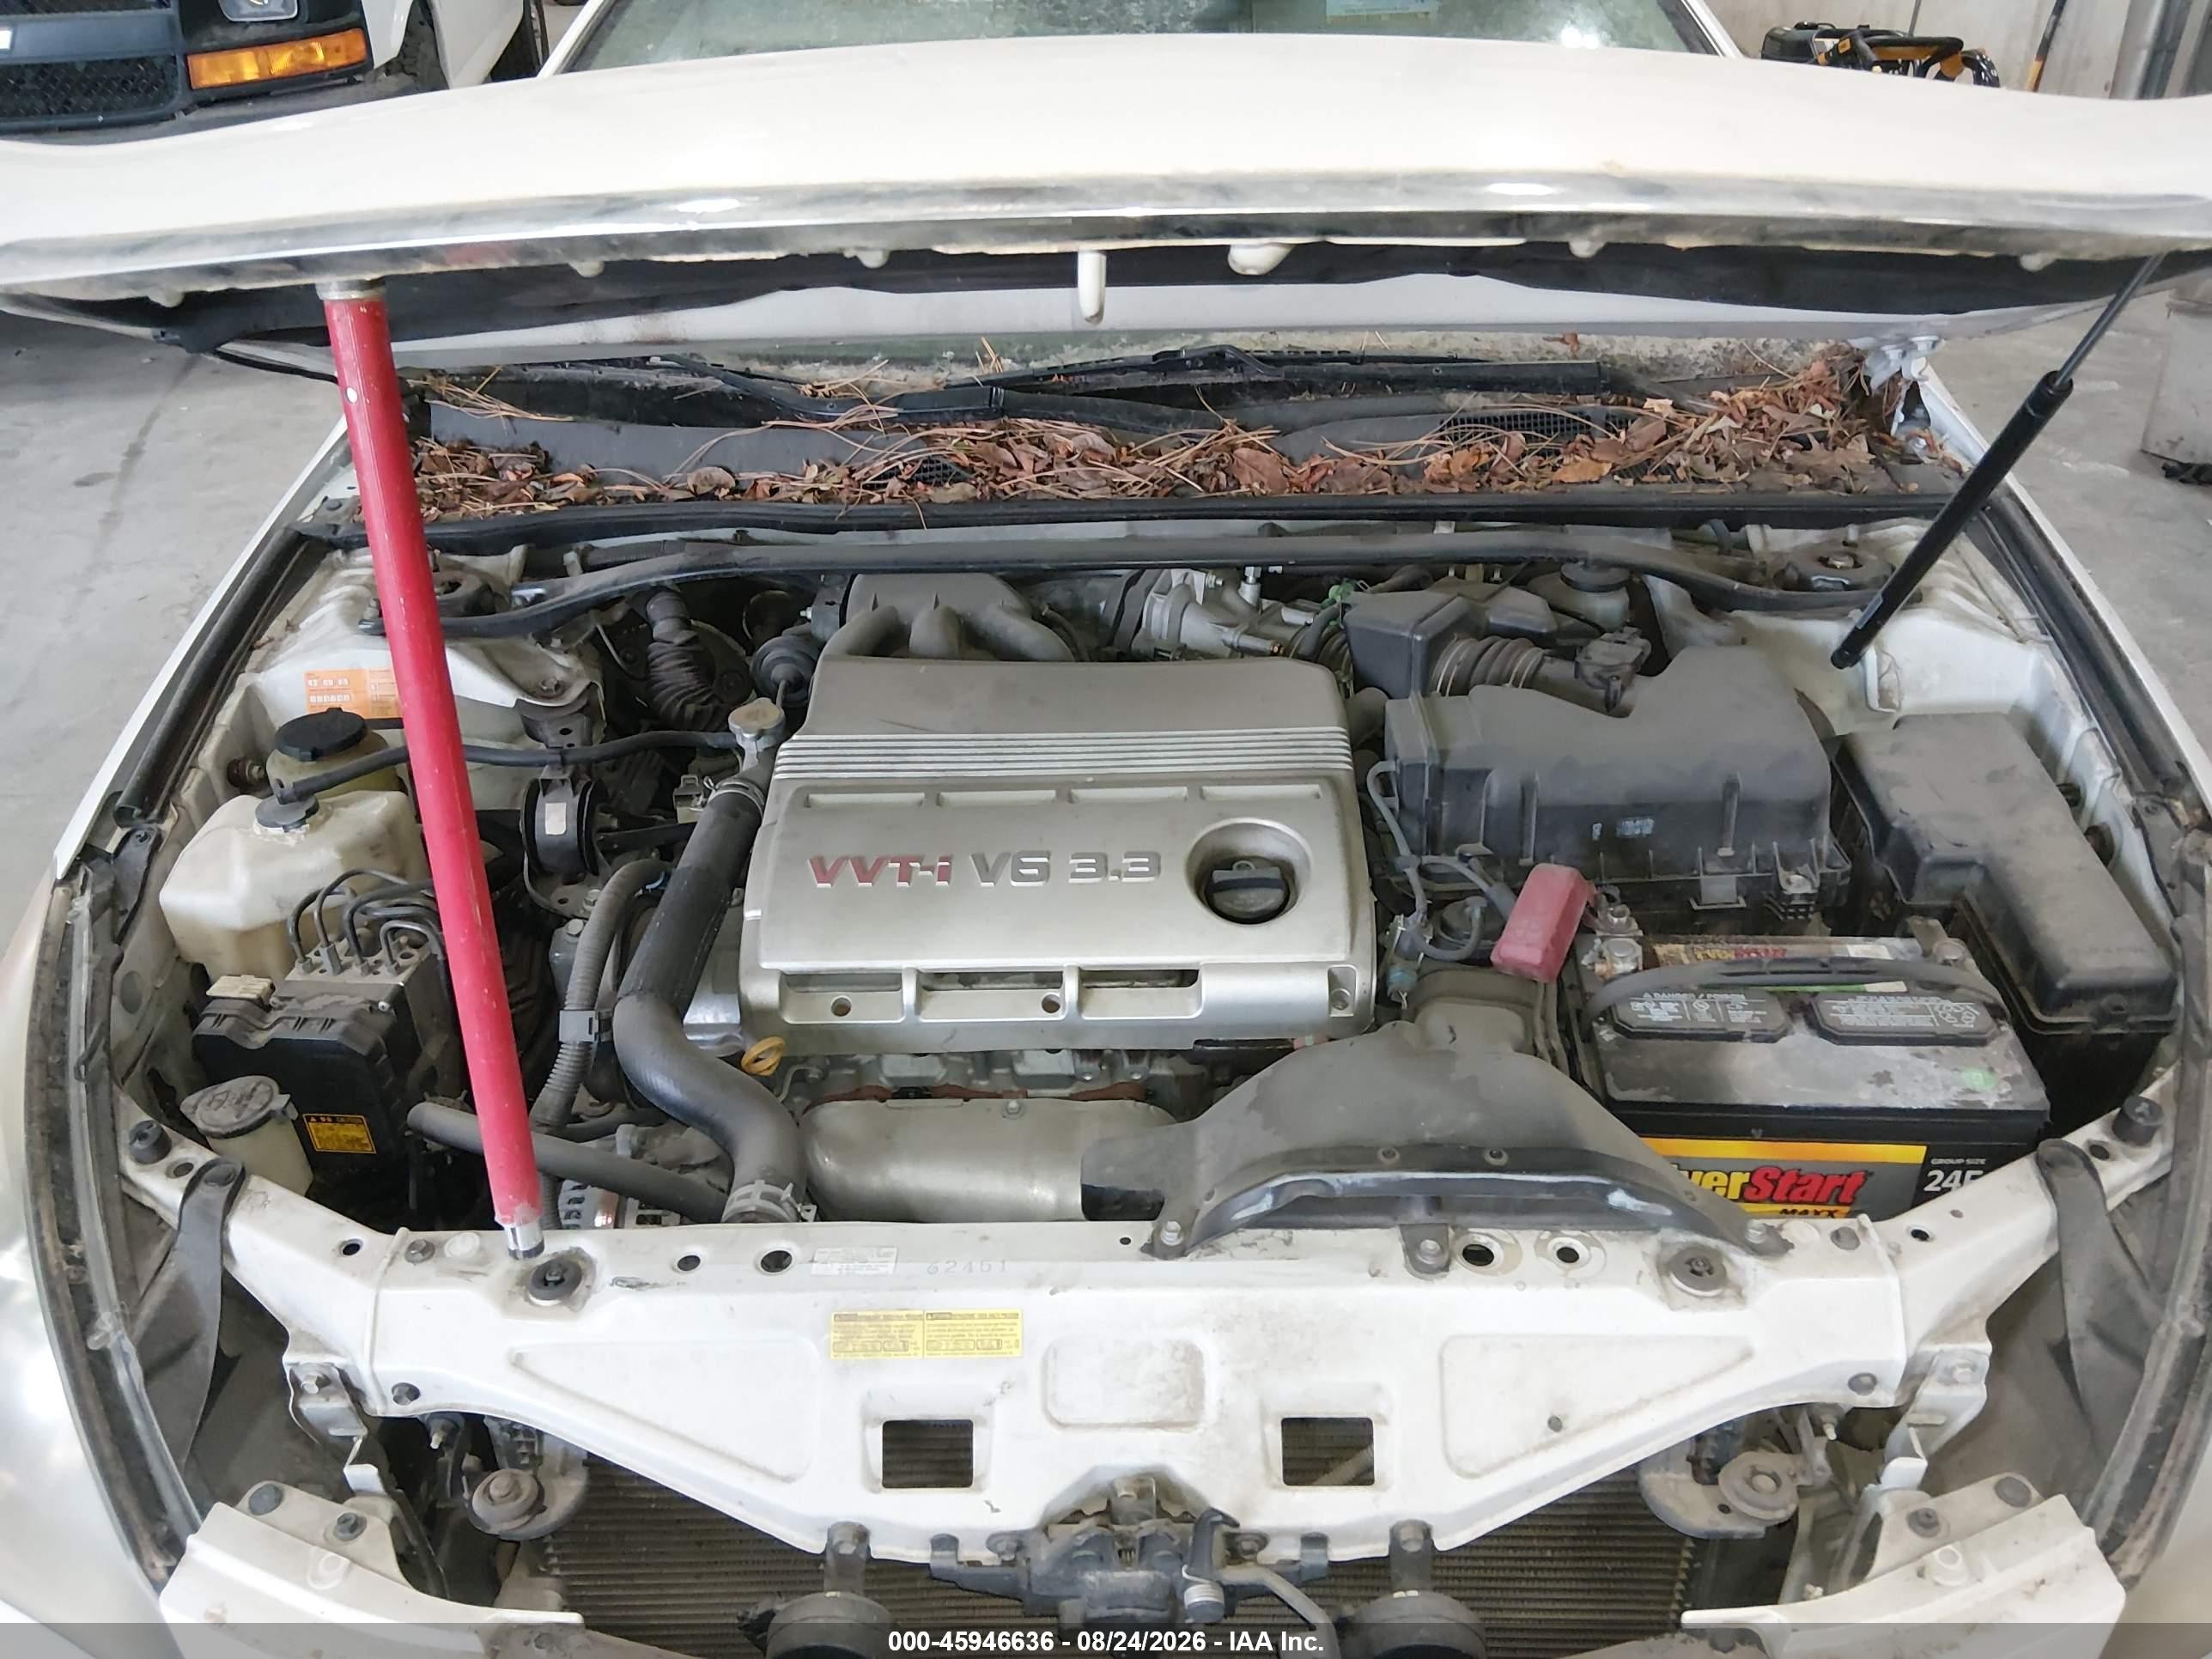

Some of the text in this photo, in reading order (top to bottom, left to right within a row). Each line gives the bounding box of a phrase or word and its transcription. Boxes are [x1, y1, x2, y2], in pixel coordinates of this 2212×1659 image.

[810, 852, 1161, 889] VVT-i V6 3.3
